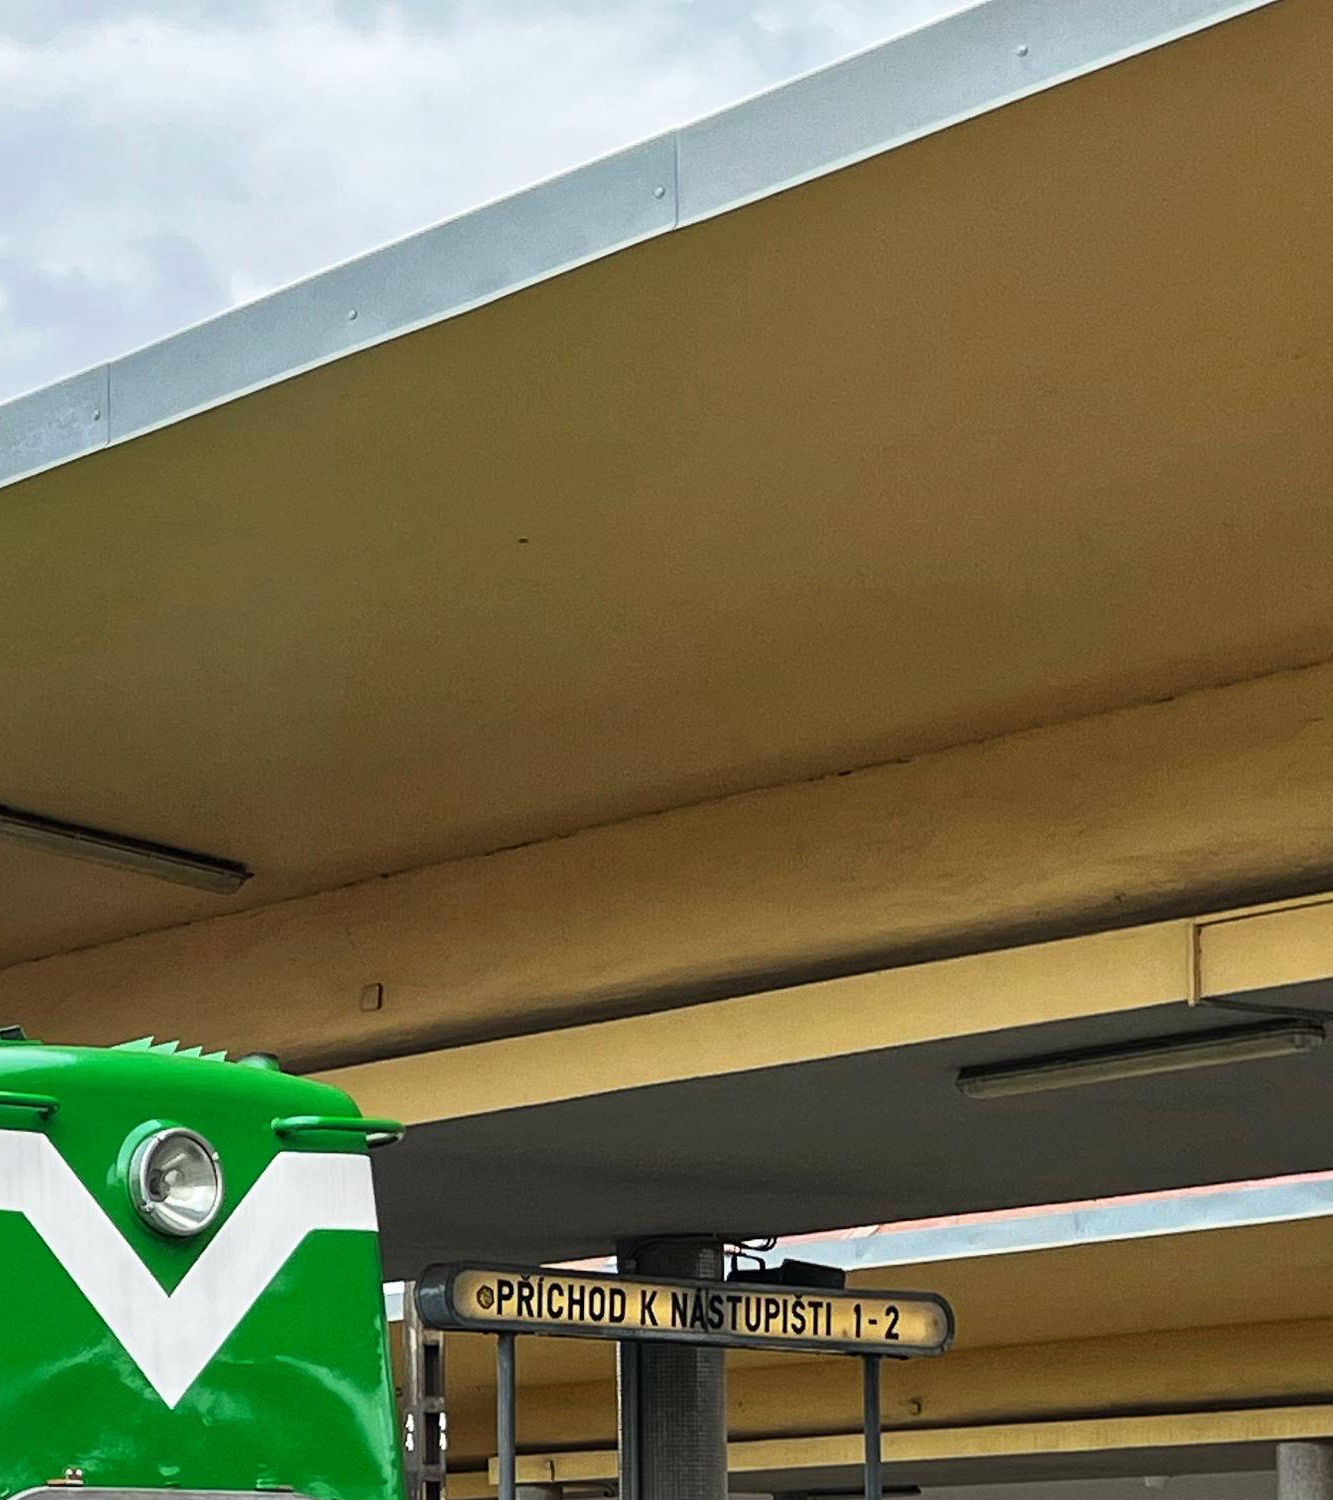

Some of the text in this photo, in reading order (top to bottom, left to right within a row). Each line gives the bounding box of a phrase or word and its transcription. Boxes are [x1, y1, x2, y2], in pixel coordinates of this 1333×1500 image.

[496, 1274, 626, 1324] PŘÍCHOD
[640, 1289, 658, 1327] K
[671, 1287, 831, 1337] NÁSTUPIŠTI
